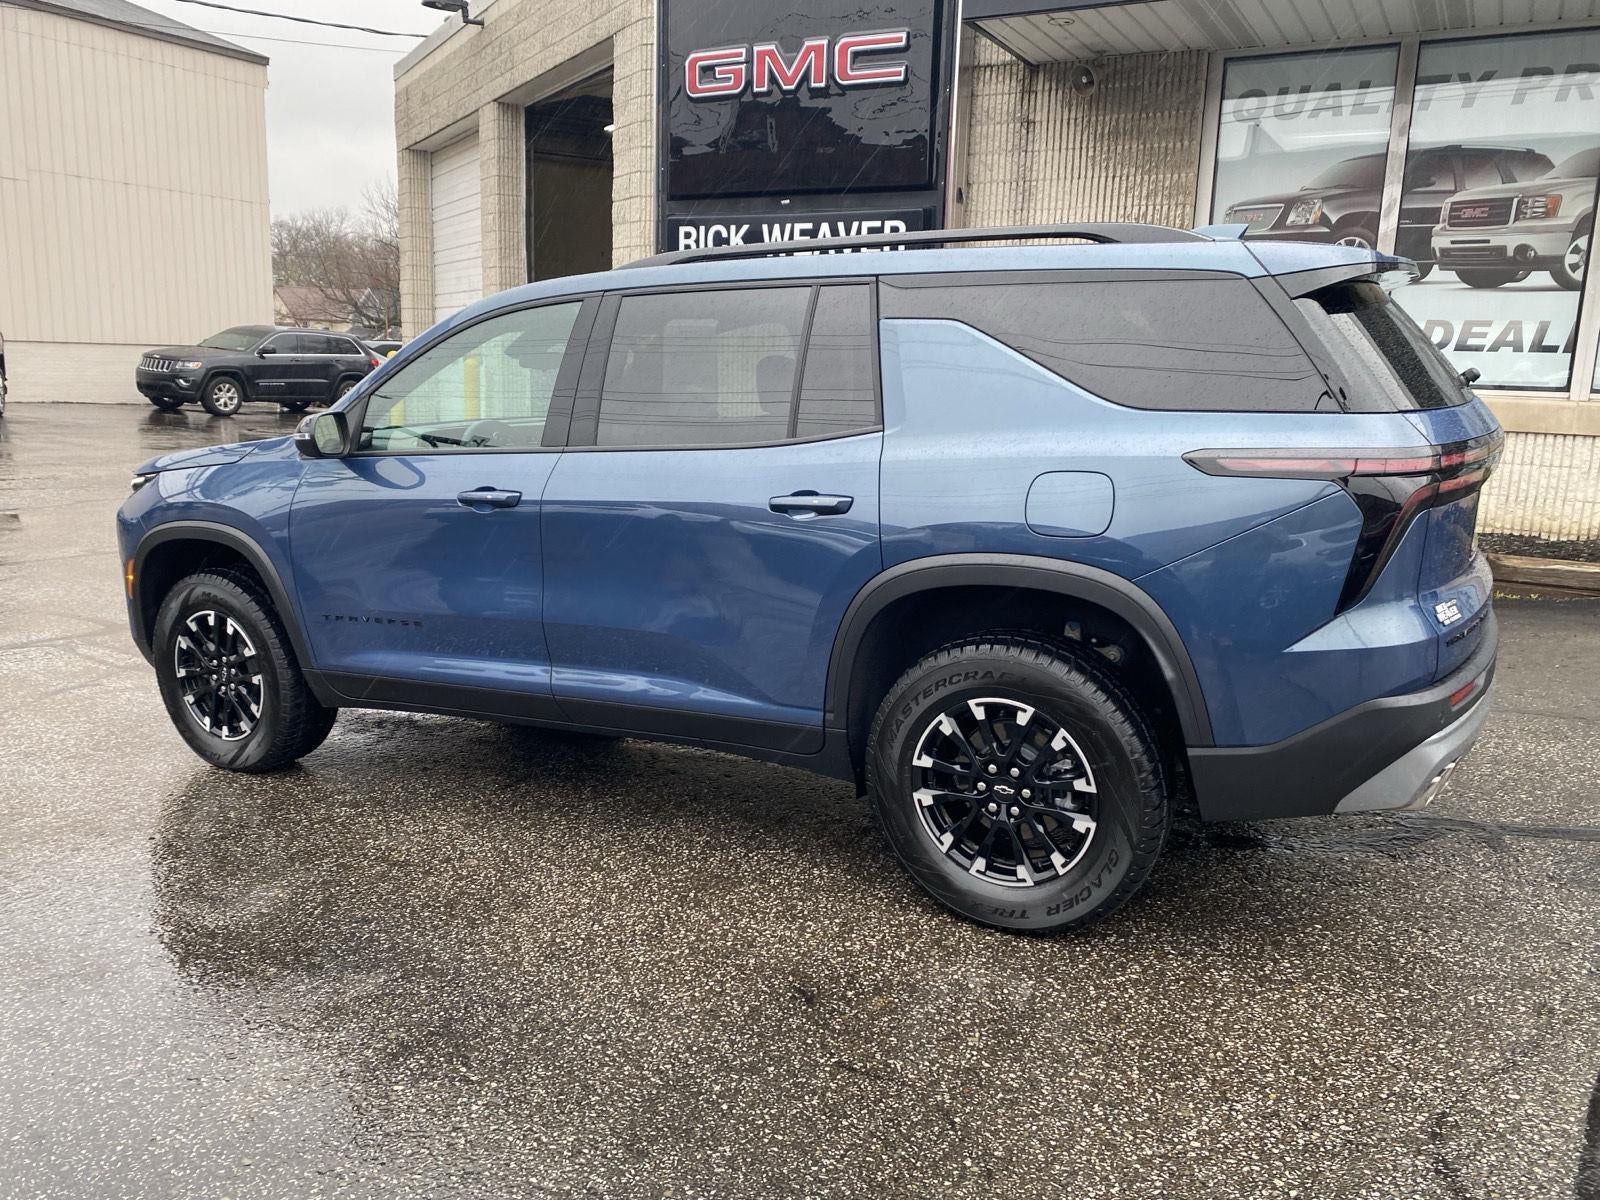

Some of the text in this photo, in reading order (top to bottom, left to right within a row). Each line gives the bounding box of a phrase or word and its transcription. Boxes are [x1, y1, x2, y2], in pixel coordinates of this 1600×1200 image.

[685, 30, 909, 98] GMC
[887, 670, 1029, 748] MASTERCRAFT
[1046, 848, 1120, 918] GLACIER
